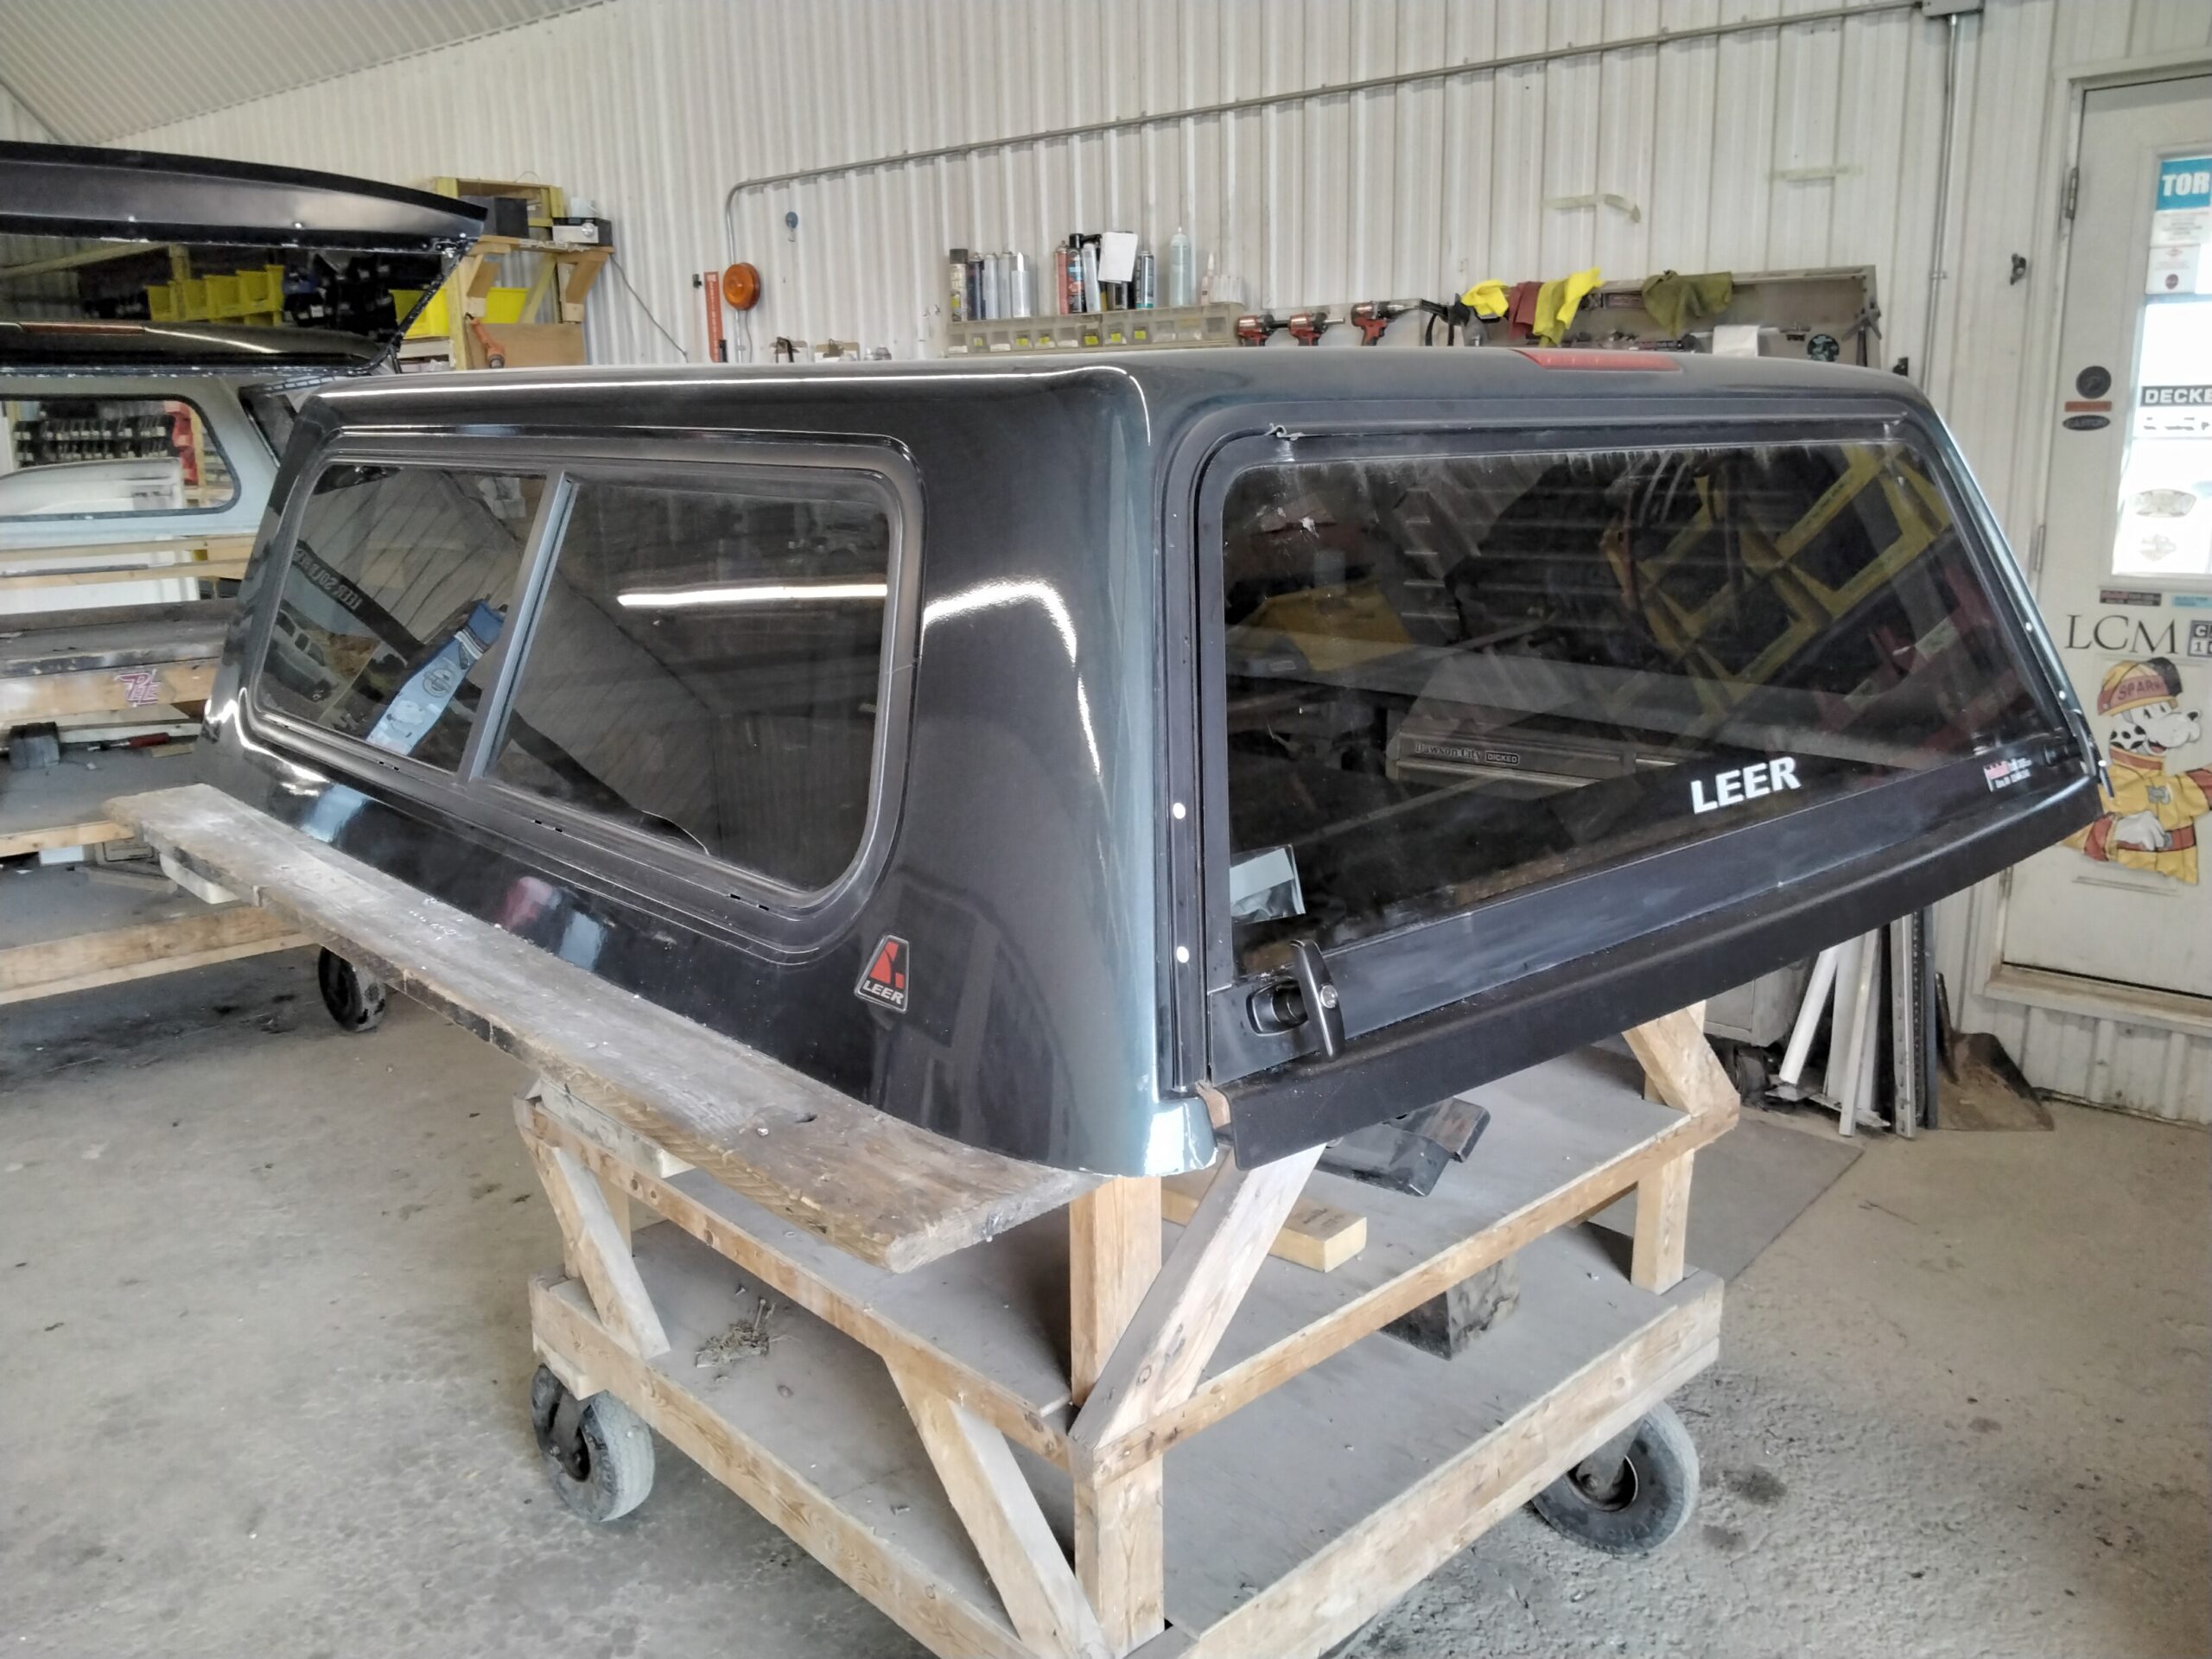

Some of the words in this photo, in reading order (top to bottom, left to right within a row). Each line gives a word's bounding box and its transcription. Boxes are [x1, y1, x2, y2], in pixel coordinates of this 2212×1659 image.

[2064, 614, 2178, 654] LCM
[1690, 756, 1802, 815] LEER
[862, 980, 905, 1005] LEER
